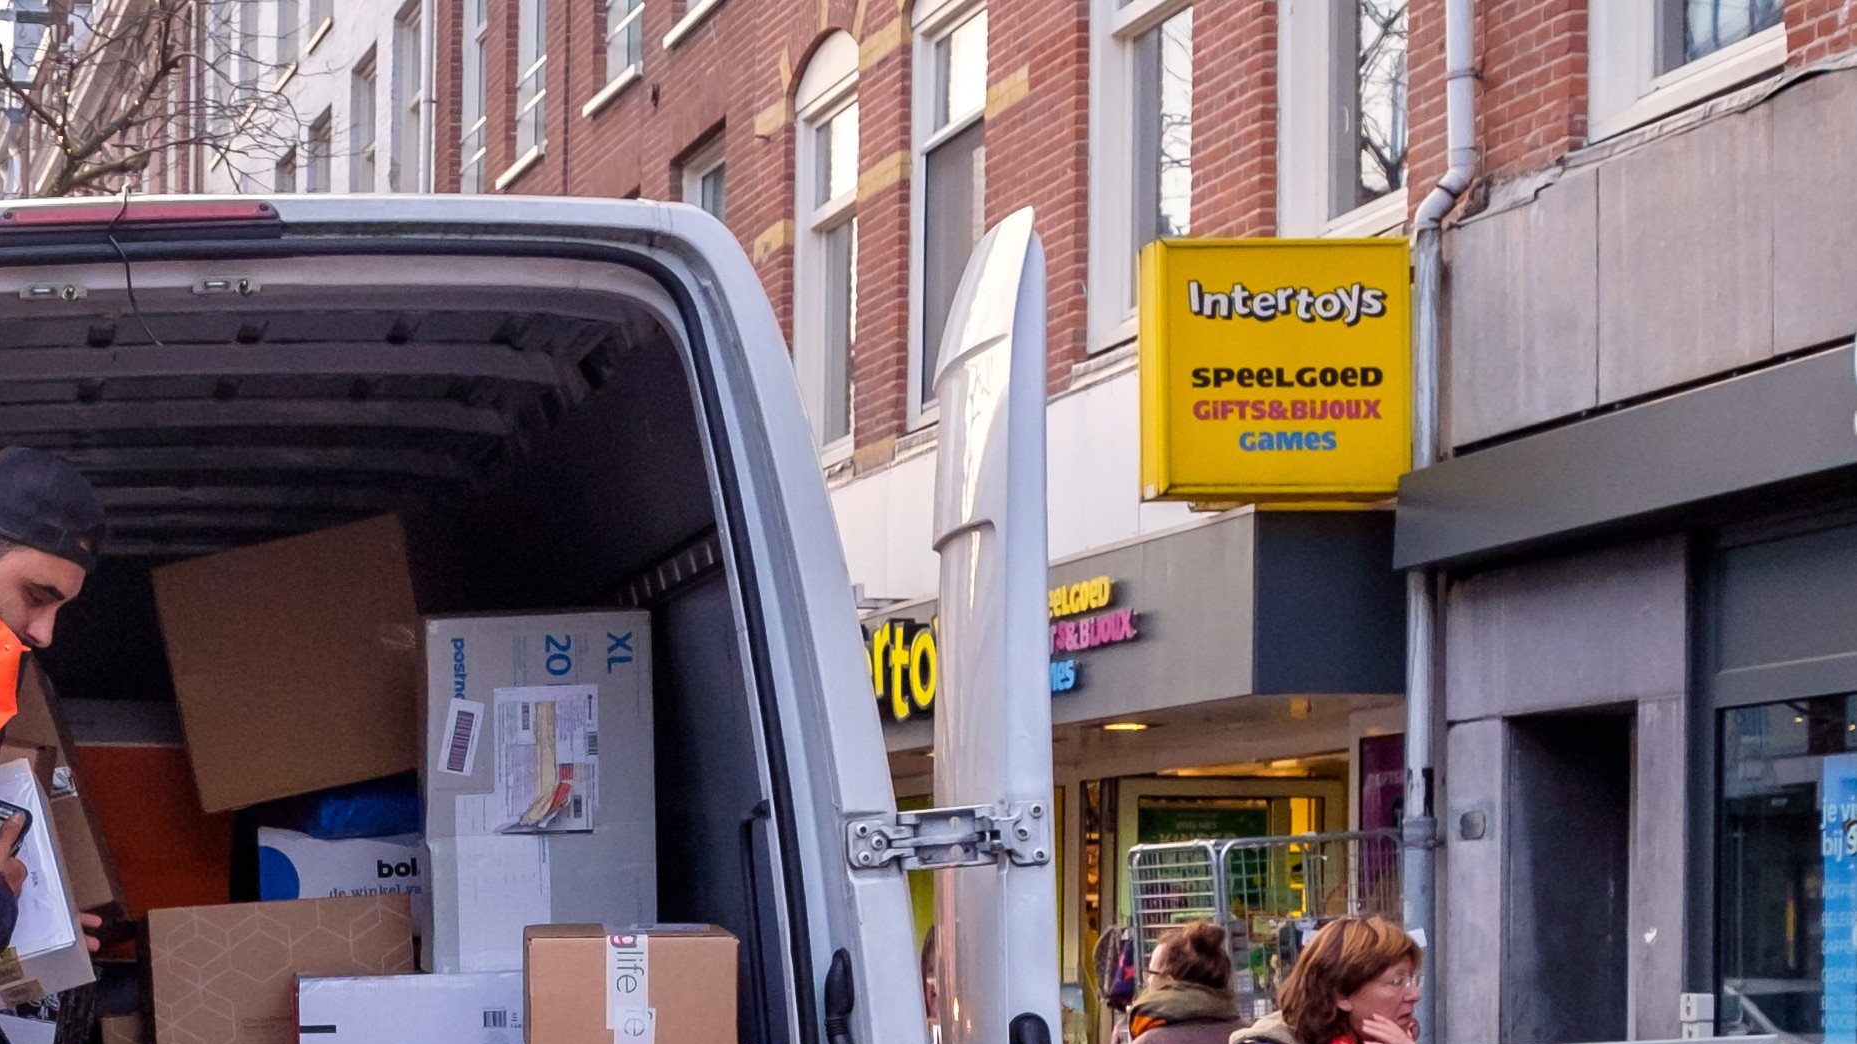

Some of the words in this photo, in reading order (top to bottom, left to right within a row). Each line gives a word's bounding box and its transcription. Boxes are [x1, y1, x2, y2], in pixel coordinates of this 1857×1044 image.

[1188, 279, 1388, 327] Intertoys
[545, 635, 572, 676] 20
[606, 631, 633, 674] XL
[865, 614, 938, 722] rto
